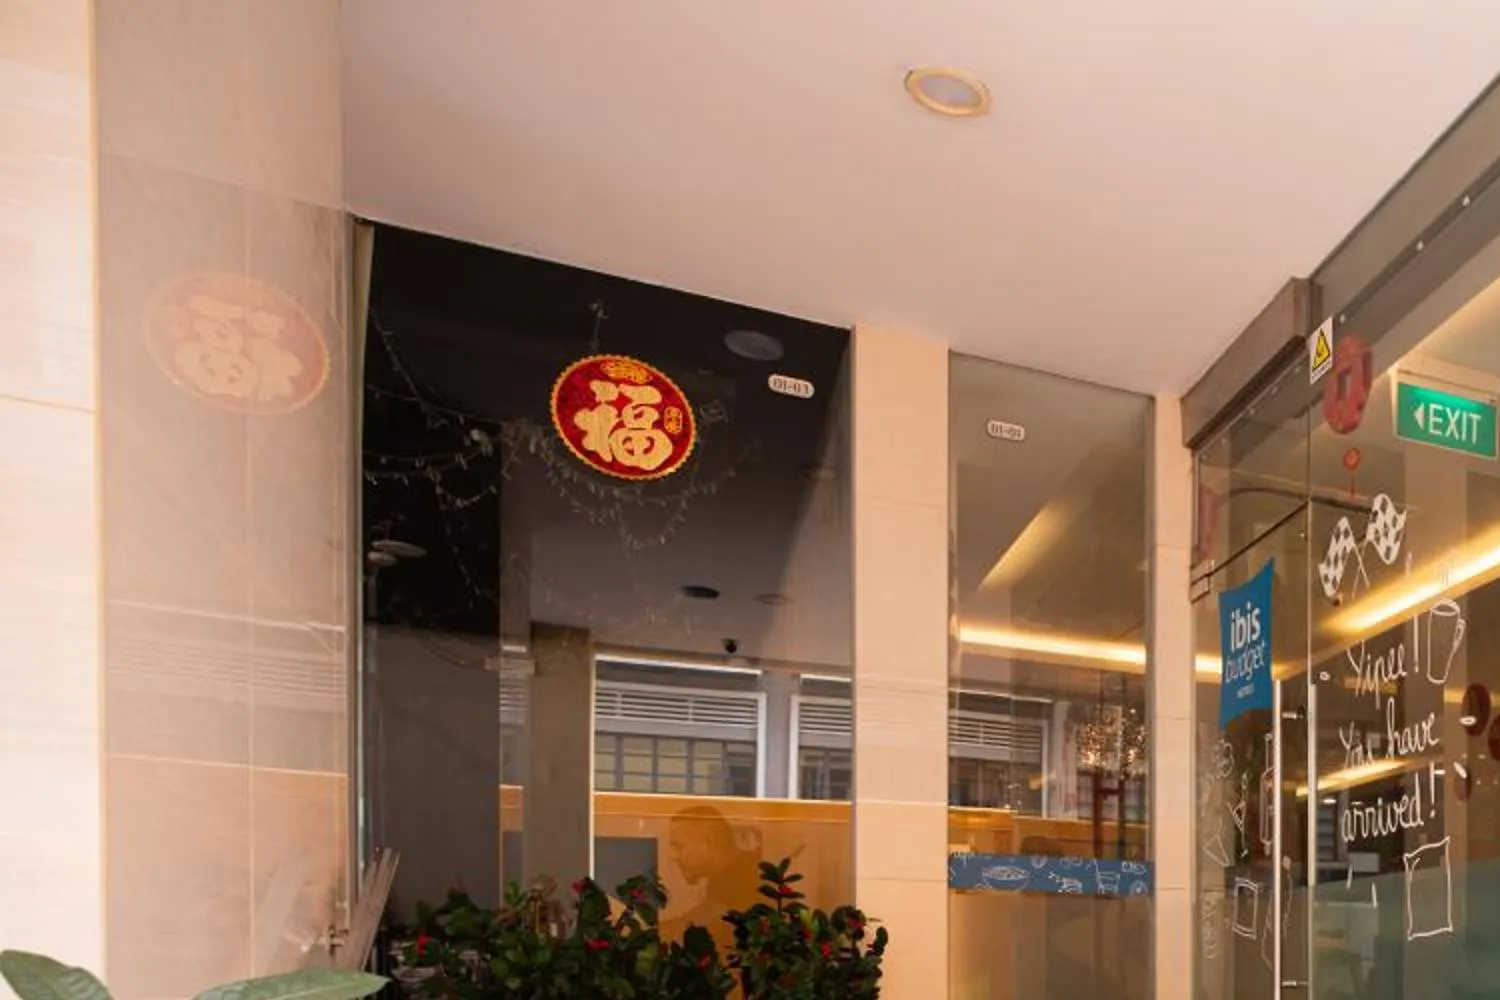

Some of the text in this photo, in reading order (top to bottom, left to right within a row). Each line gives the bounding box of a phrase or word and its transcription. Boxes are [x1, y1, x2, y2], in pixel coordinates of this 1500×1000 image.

[574, 379, 673, 470] 福
[1429, 403, 1482, 445] EXIT
[1231, 600, 1261, 654] ibis
[1386, 697, 1440, 761] have
